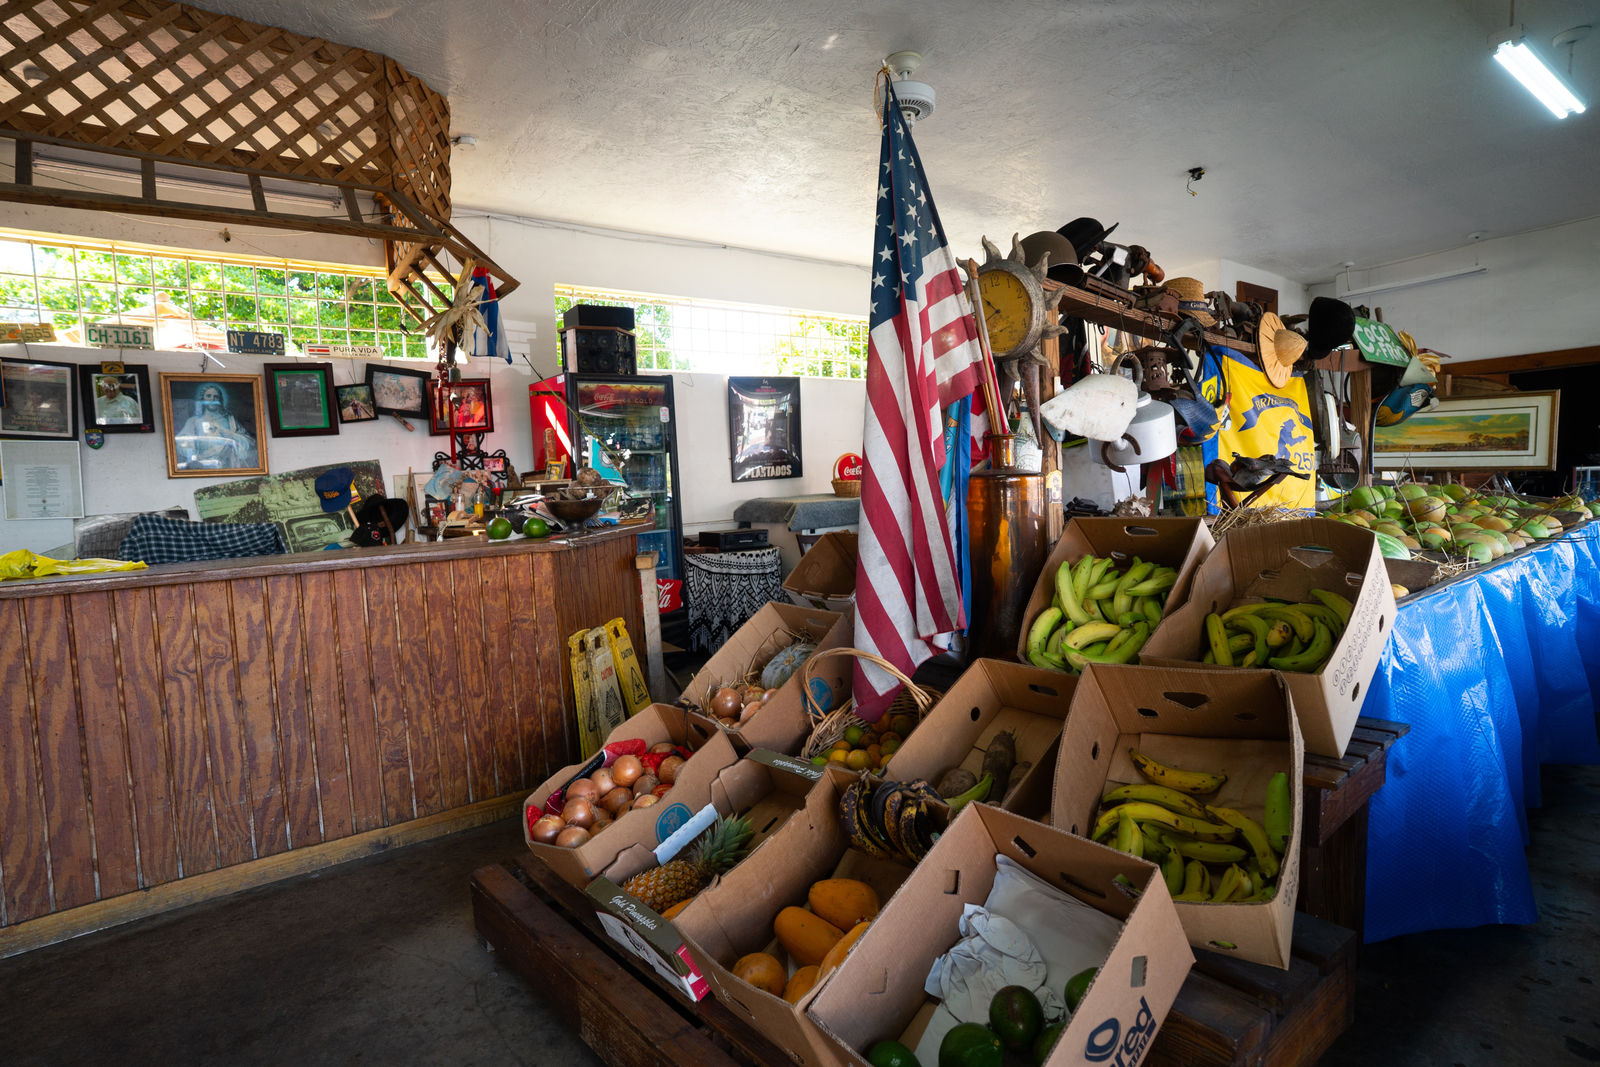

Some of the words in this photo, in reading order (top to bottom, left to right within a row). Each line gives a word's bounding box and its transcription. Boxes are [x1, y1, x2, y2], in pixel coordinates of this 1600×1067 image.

[230, 333, 245, 347] NT
[253, 334, 283, 349] 4783
[608, 895, 630, 909] Gold
[623, 903, 657, 931] Pineapples
[1109, 995, 1153, 1067] red
